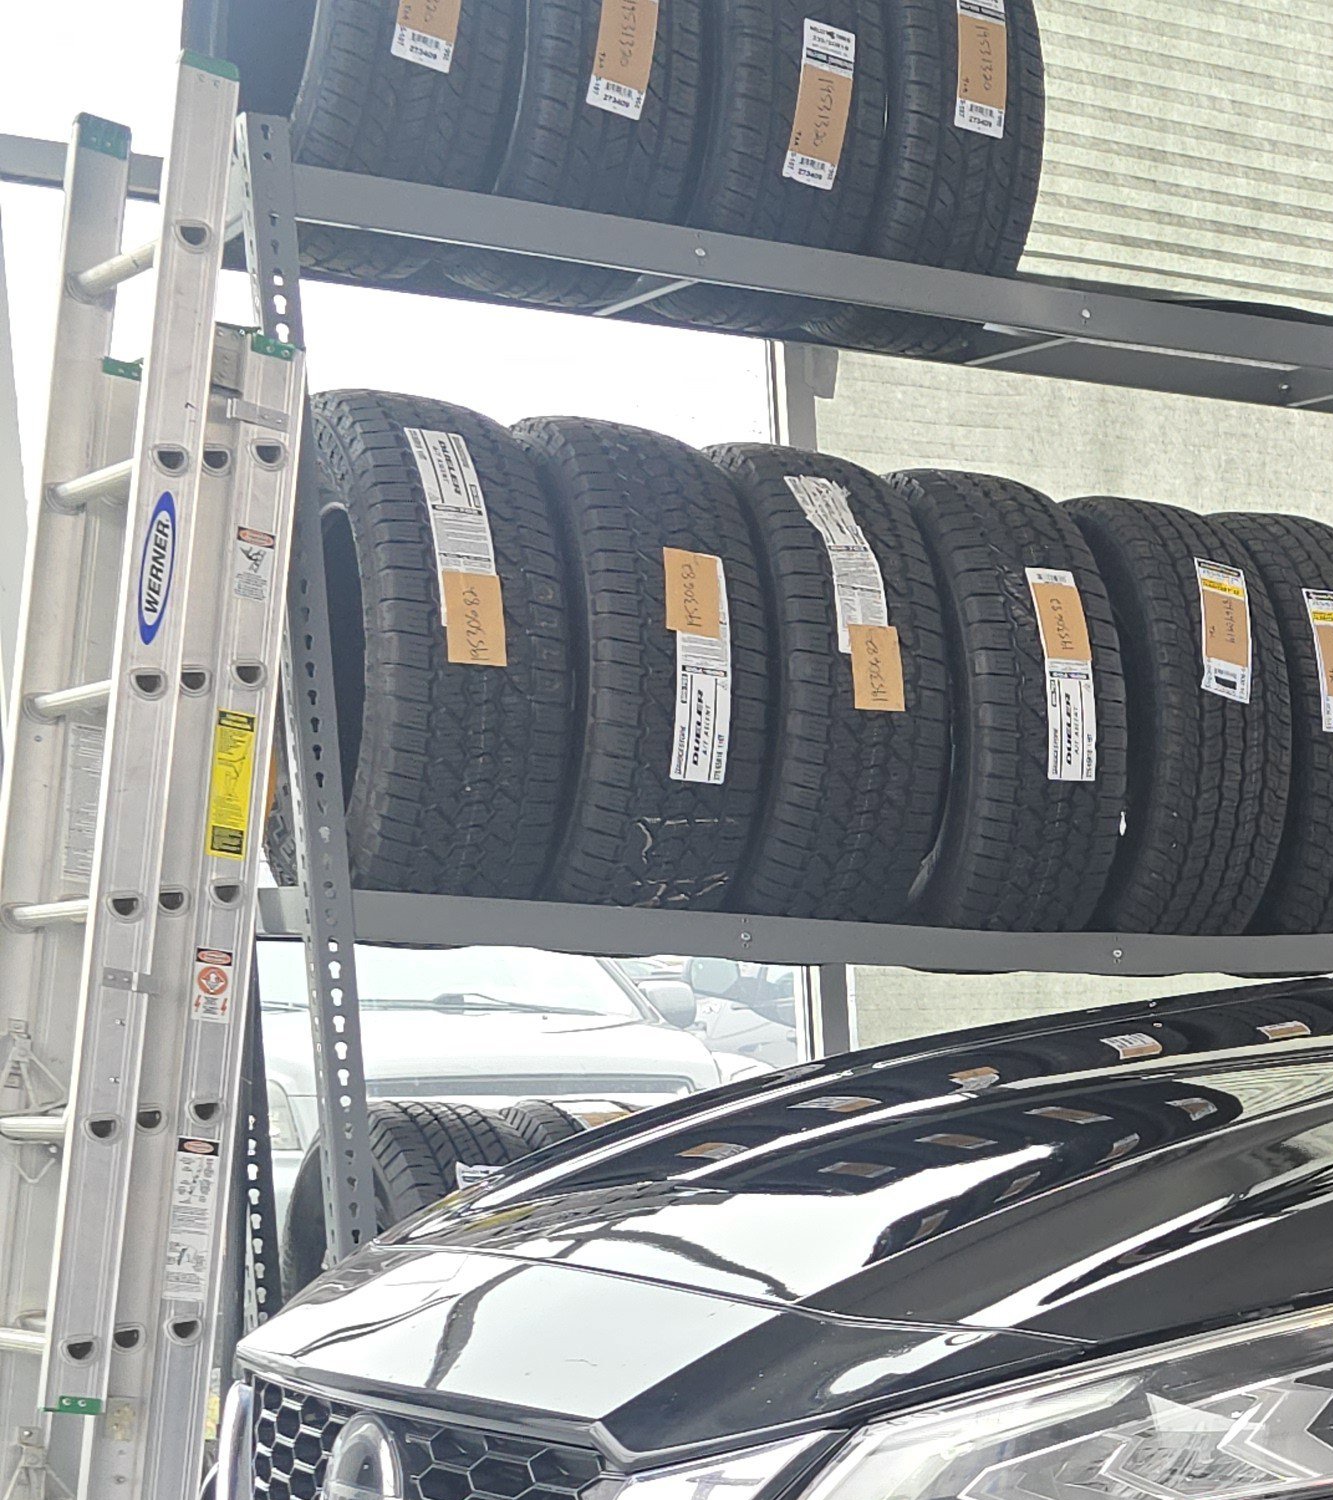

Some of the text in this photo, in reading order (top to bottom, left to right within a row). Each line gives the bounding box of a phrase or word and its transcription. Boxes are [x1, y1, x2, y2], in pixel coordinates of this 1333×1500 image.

[438, 440, 462, 496] DUELER
[144, 519, 170, 615] WERNER
[692, 689, 704, 767] DUELER
[1064, 692, 1073, 767] DUELER
